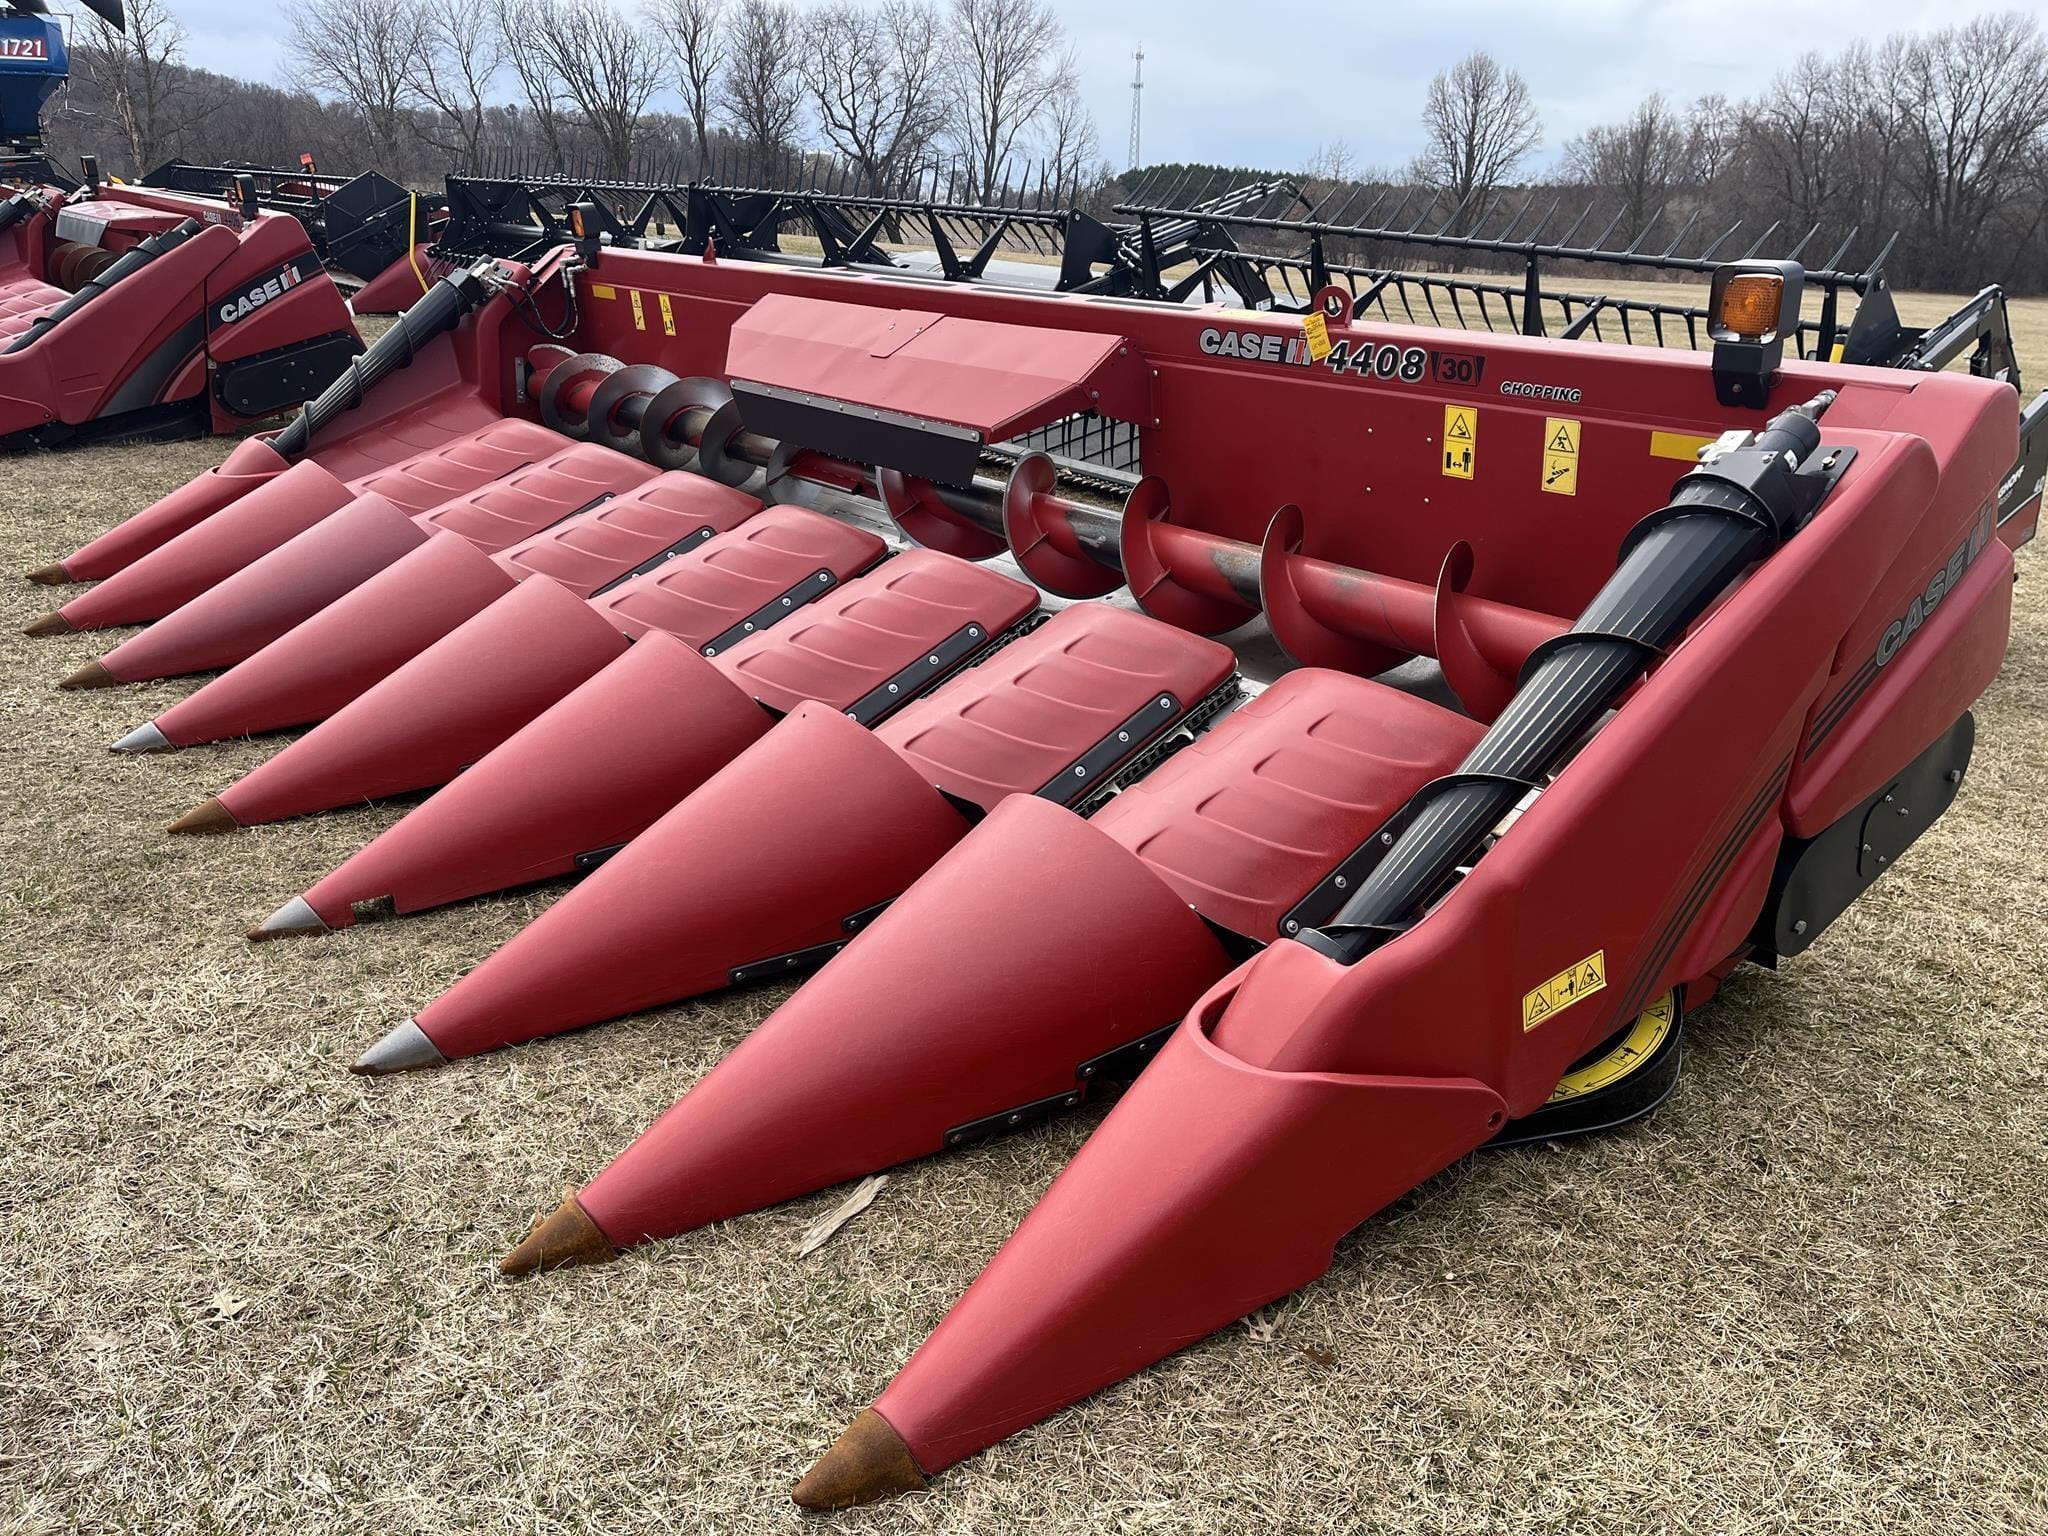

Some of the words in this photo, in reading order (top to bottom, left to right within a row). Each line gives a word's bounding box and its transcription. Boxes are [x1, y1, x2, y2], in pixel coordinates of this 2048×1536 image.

[2, 39, 43, 57] 1721
[220, 278, 282, 323] CASE
[1199, 328, 1284, 362] CASE
[1324, 339, 1428, 383] 4408
[1441, 357, 1473, 382] 30
[1500, 380, 1582, 403] CHOPPING
[1875, 538, 1968, 667] CASE
